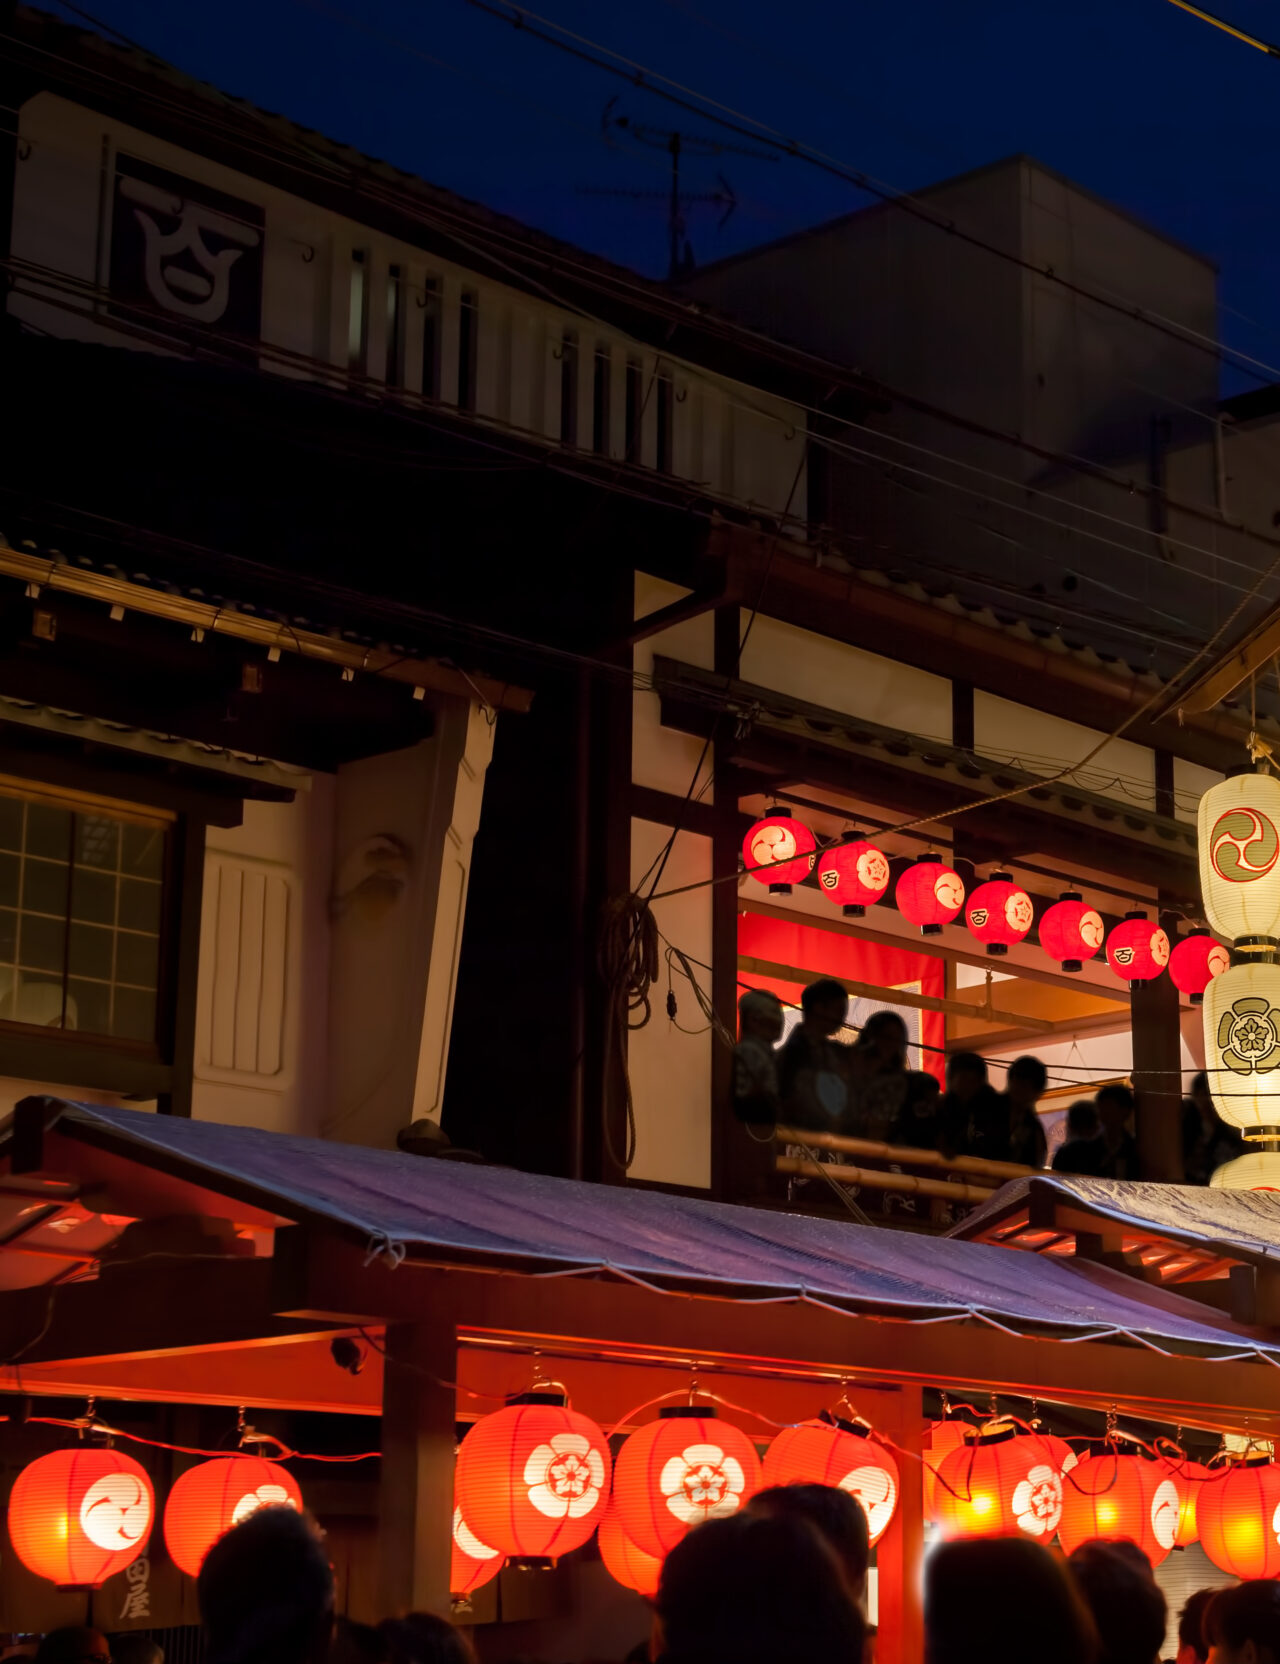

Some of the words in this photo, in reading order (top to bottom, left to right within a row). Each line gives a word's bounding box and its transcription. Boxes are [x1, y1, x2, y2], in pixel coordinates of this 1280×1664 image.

[119, 177, 260, 323] 百
[821, 870, 838, 889] 百
[971, 908, 989, 927] 百
[1114, 947, 1134, 965] 百
